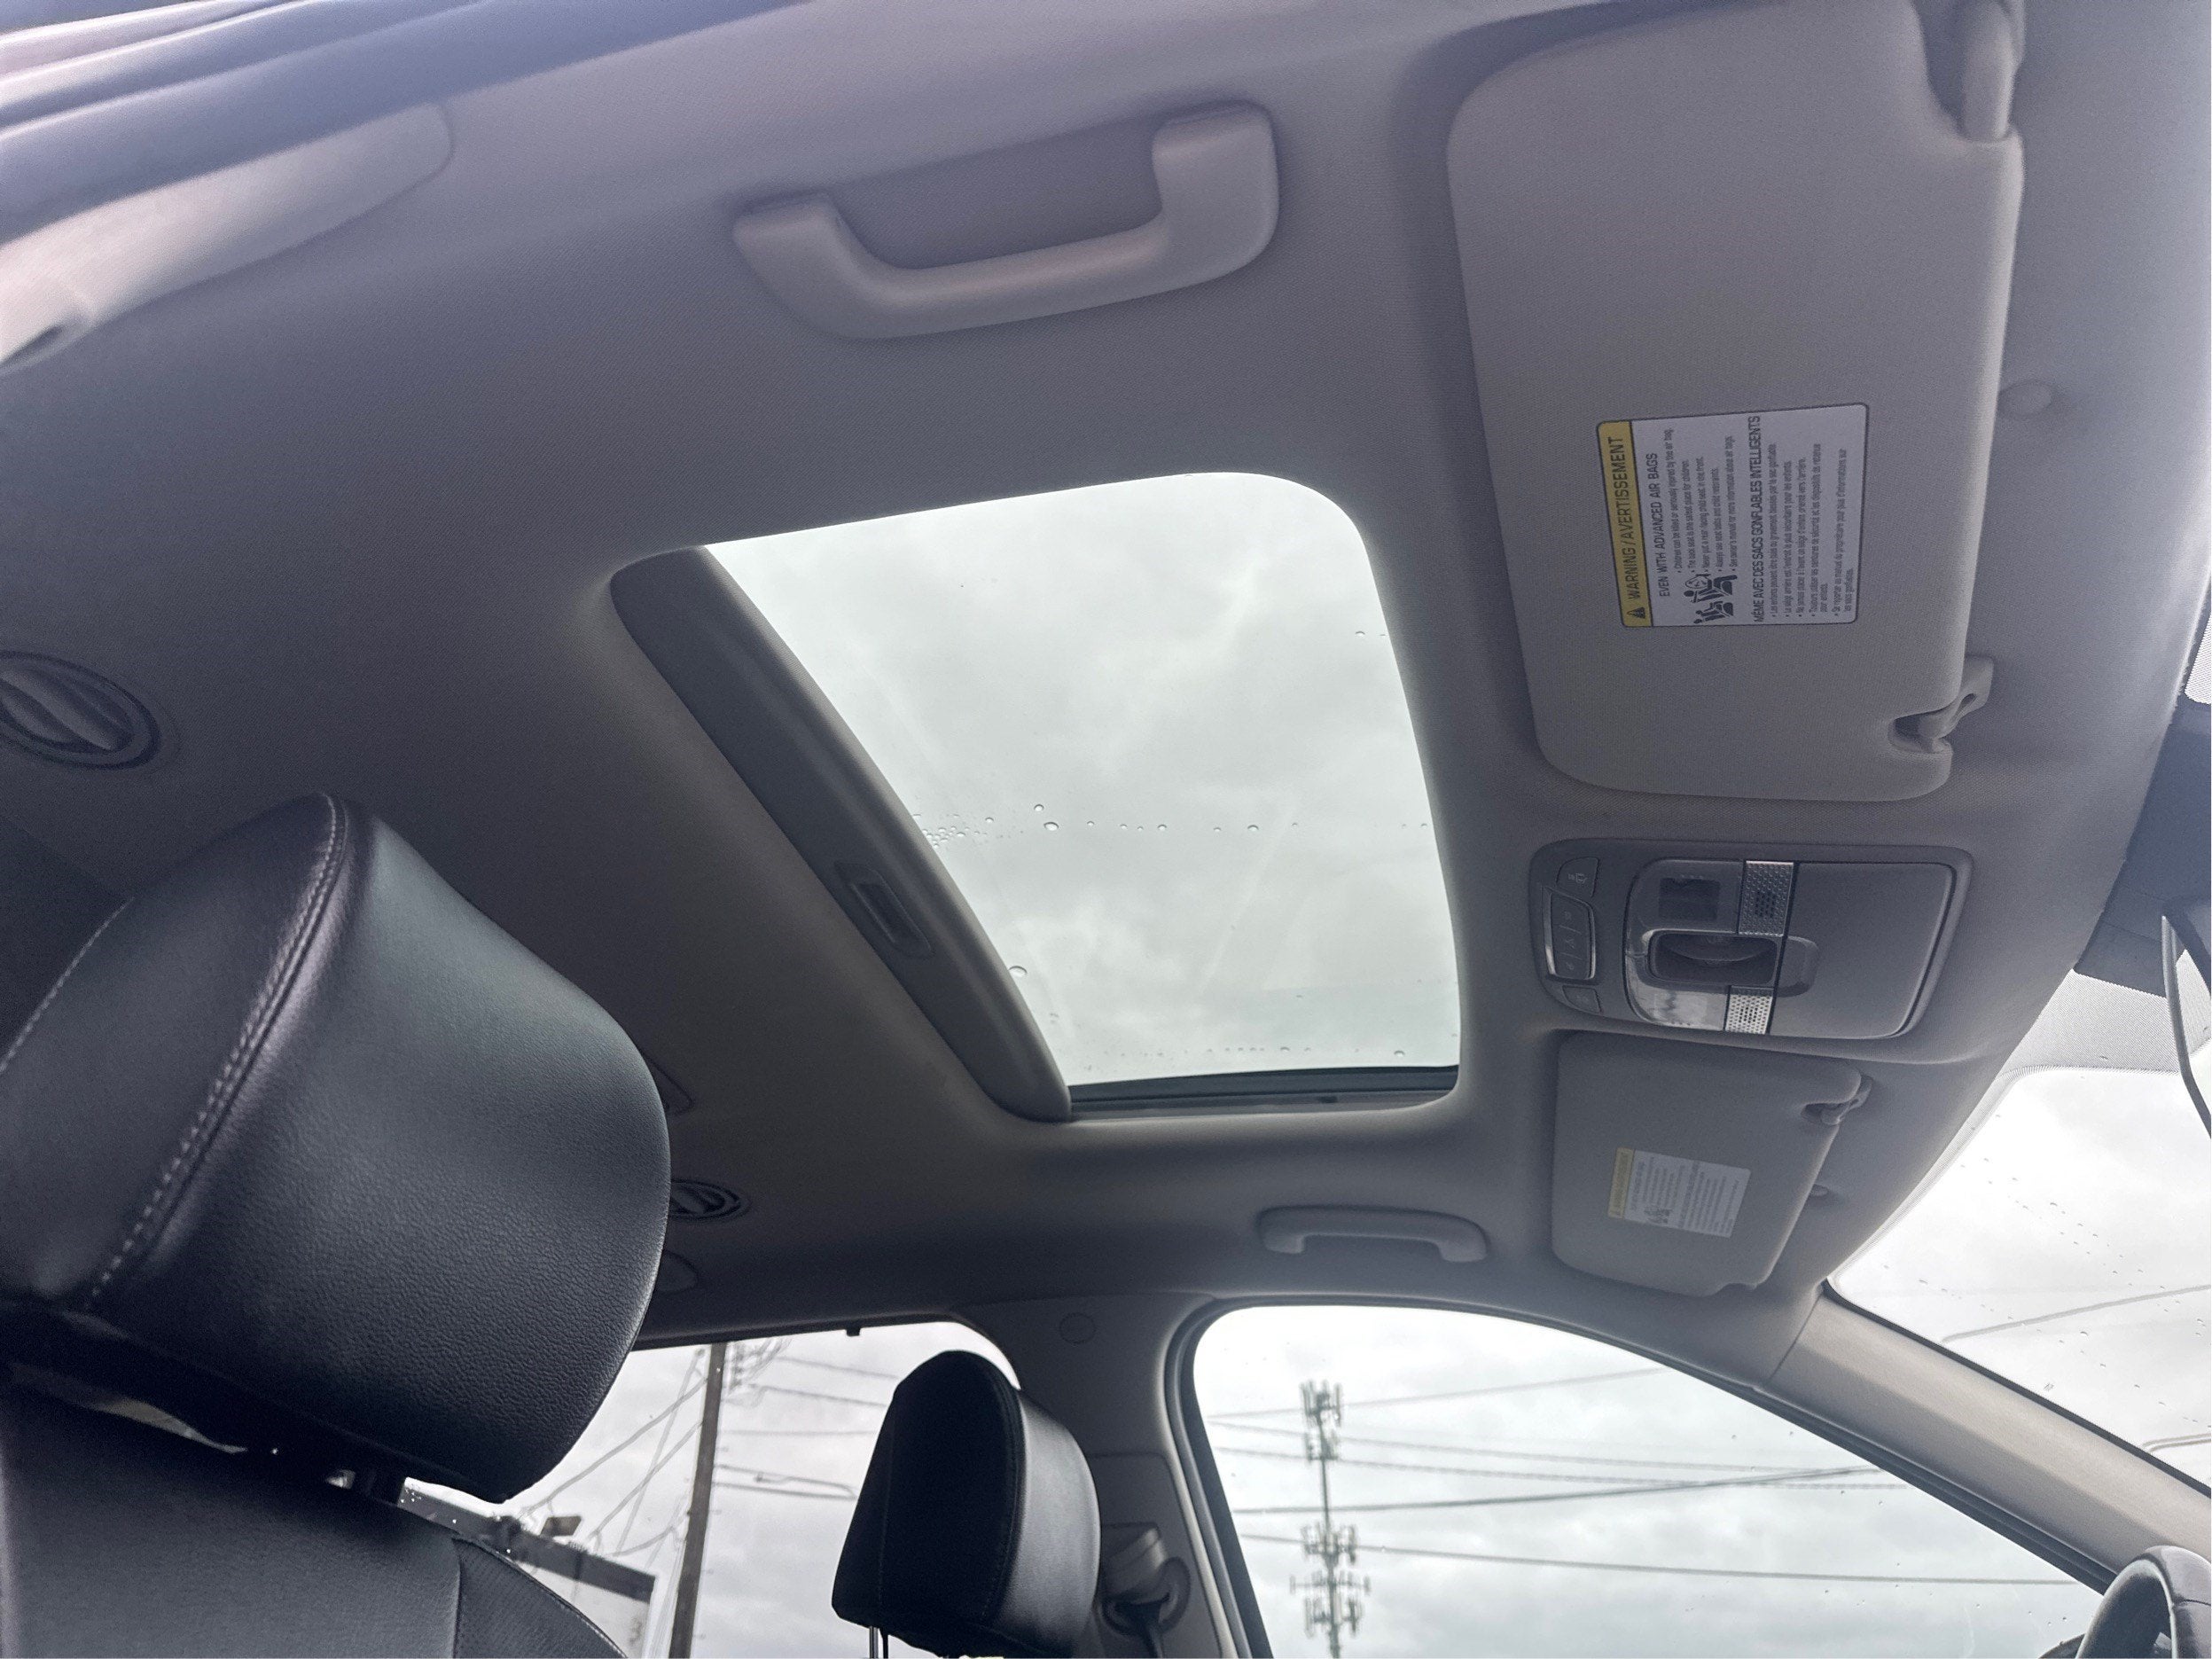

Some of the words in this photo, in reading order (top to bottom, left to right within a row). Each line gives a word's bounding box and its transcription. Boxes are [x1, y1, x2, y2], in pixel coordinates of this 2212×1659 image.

[1747, 416, 1761, 478] INTELLIGENTS
[1646, 452, 1659, 480] BAGS
[1648, 483, 1660, 498] AIR
[1749, 480, 1762, 536] GONFLABLES
[1652, 501, 1665, 549] ADVANCED
[1751, 537, 1763, 560] SACS
[1656, 552, 1668, 573] WITH
[1752, 561, 1763, 576] DES
[1659, 576, 1669, 597] EVEN
[1752, 578, 1765, 599] AVEC
[1750, 600, 1765, 622] MÊME
